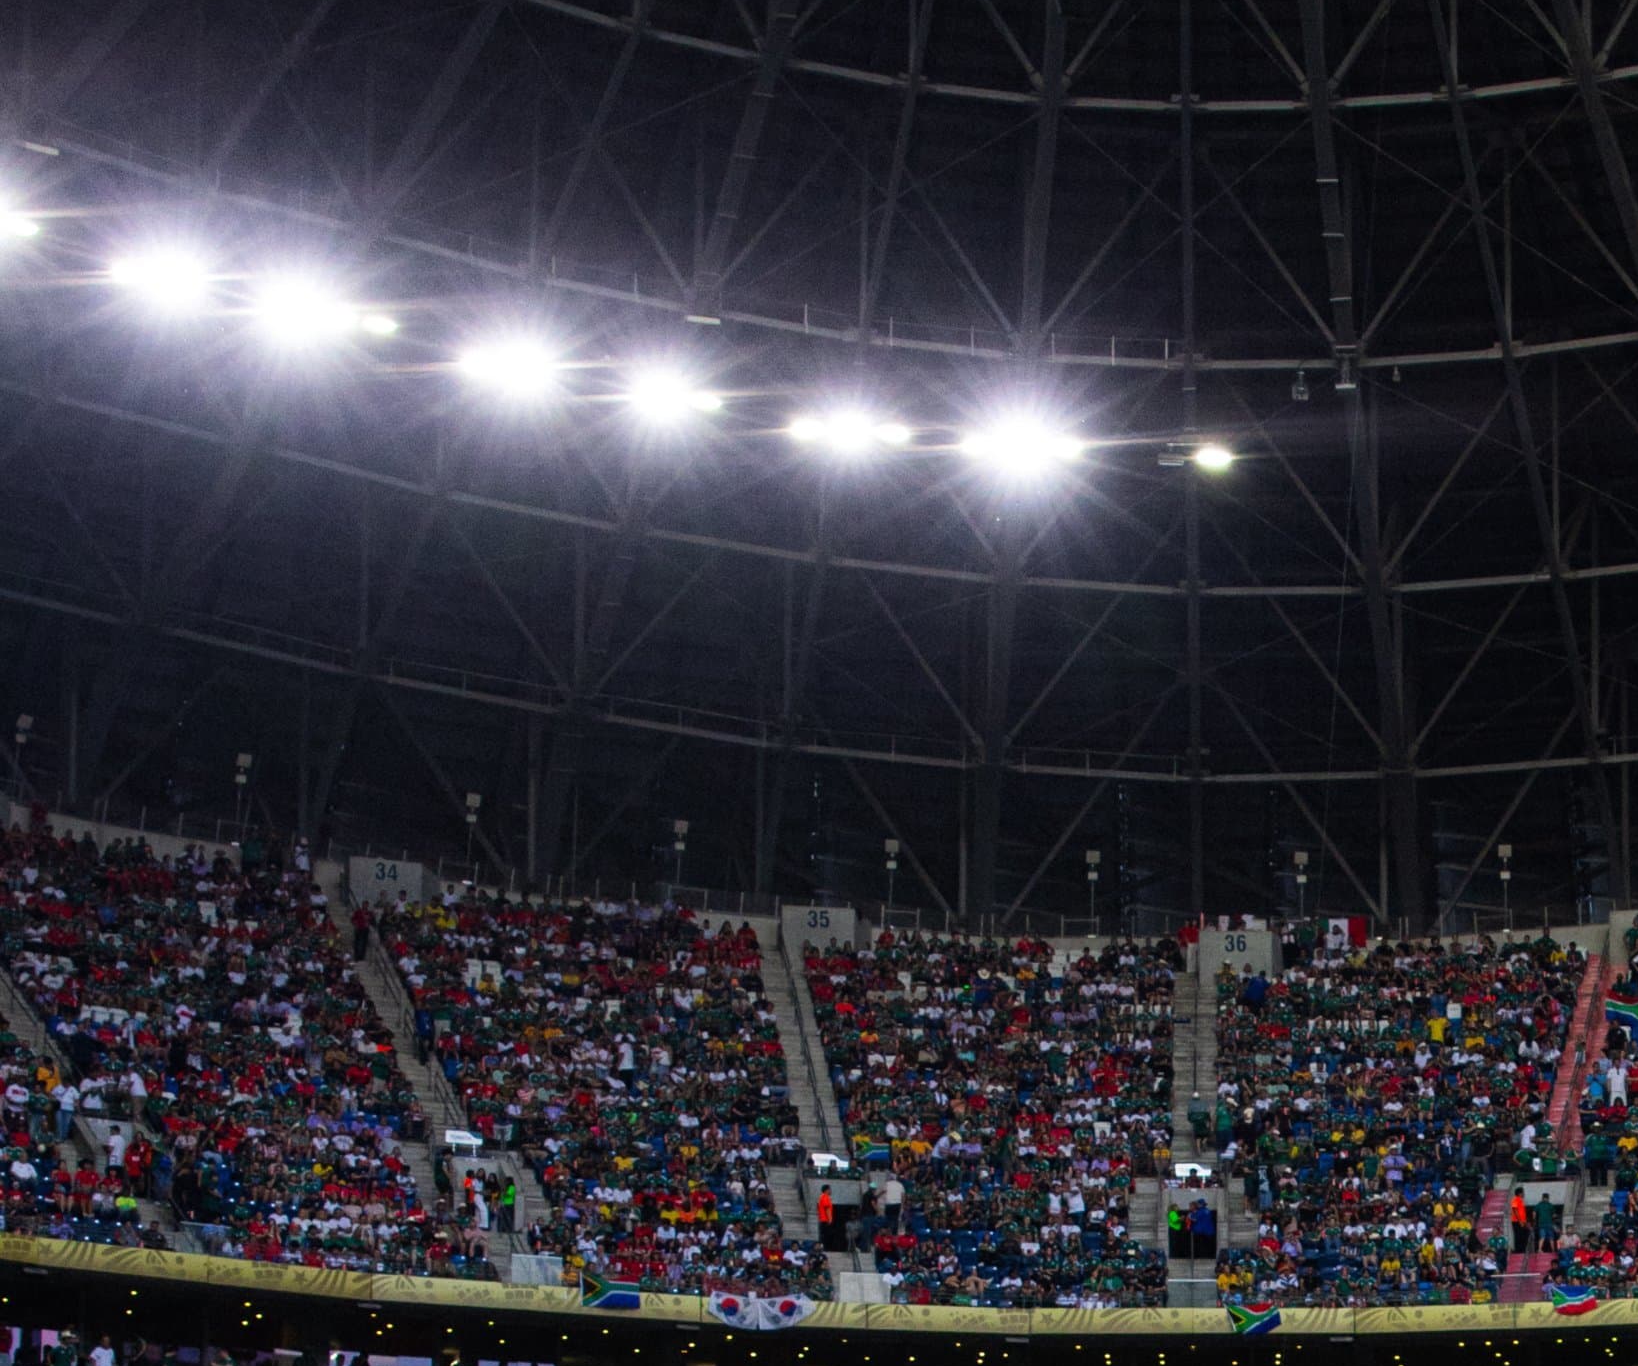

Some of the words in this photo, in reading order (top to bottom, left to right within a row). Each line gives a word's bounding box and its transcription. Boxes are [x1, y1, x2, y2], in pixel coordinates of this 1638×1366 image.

[375, 861, 397, 881] 34
[807, 910, 829, 928] 35
[1225, 934, 1246, 952] 36
